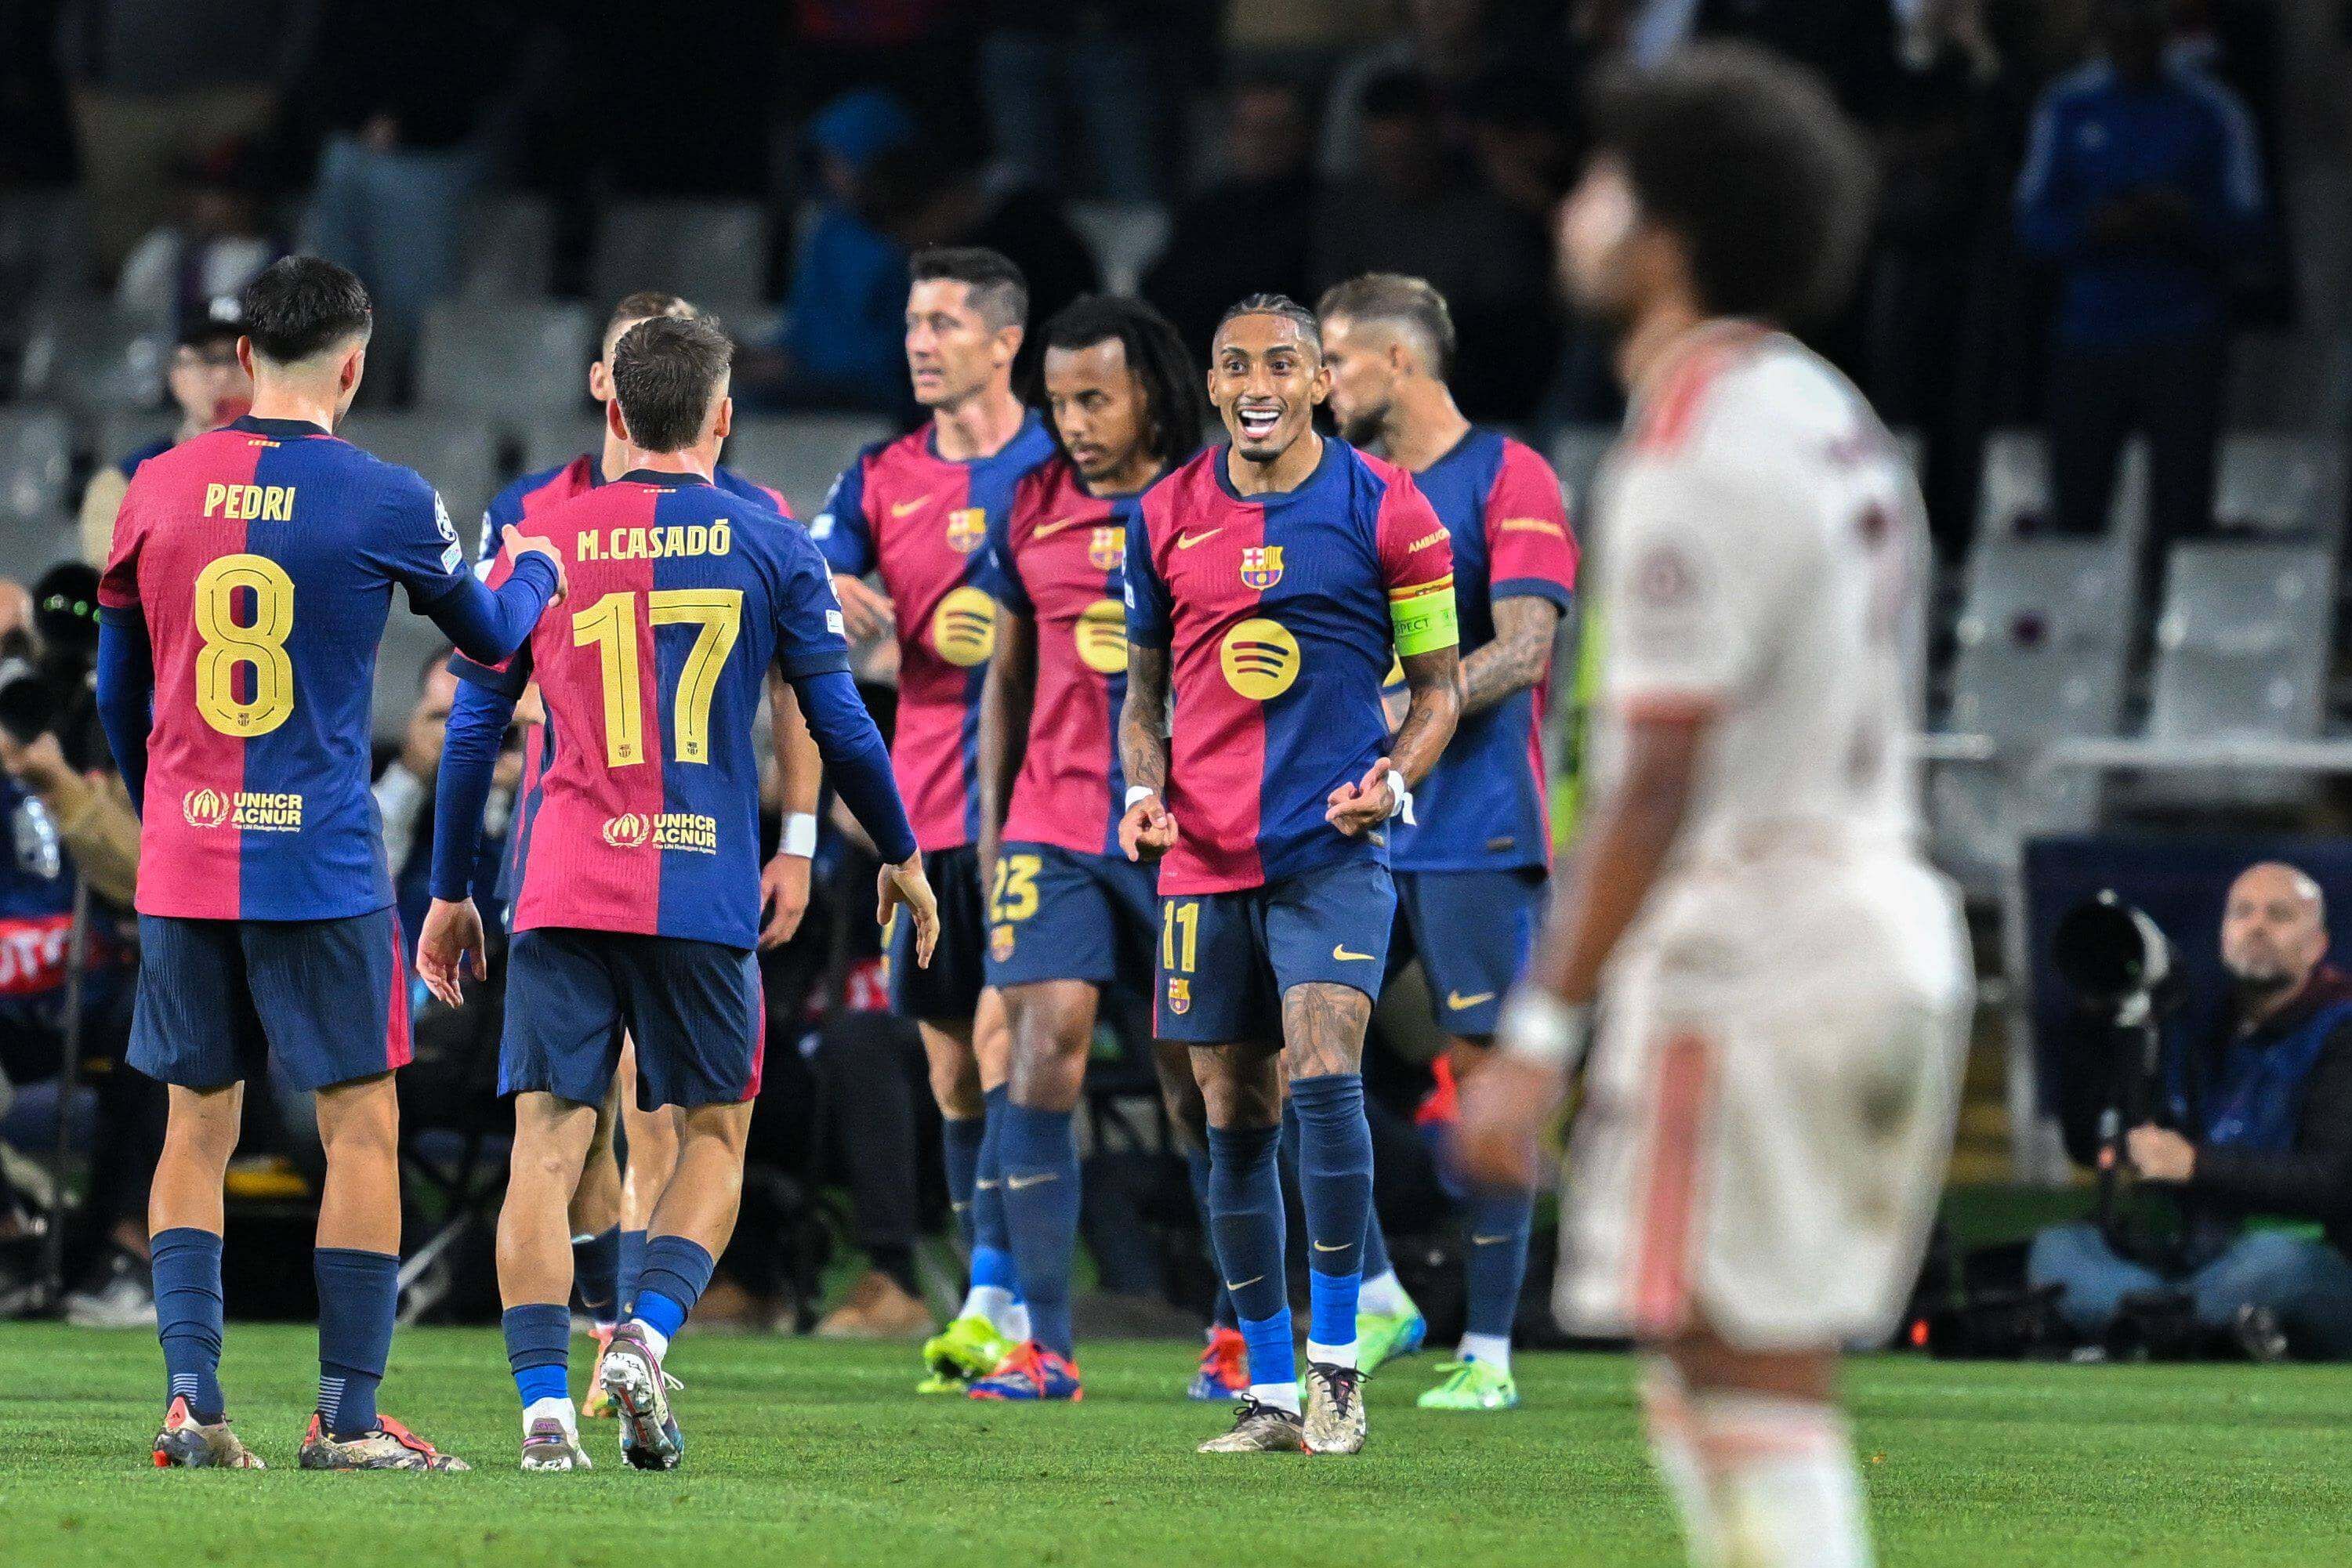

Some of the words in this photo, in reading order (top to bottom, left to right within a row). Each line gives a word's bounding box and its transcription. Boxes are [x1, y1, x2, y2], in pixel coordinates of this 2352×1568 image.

[204, 483, 296, 521] PEDRI
[577, 518, 731, 562] M.CASADÓ
[194, 553, 295, 737] 8
[572, 588, 745, 768] 17
[230, 808, 302, 825] ACNUR
[234, 792, 303, 809] UNHCR
[651, 828, 716, 848] ACNUR
[653, 813, 716, 833] UNHCR
[990, 854, 1043, 922] 23
[1163, 900, 1200, 972] 11
